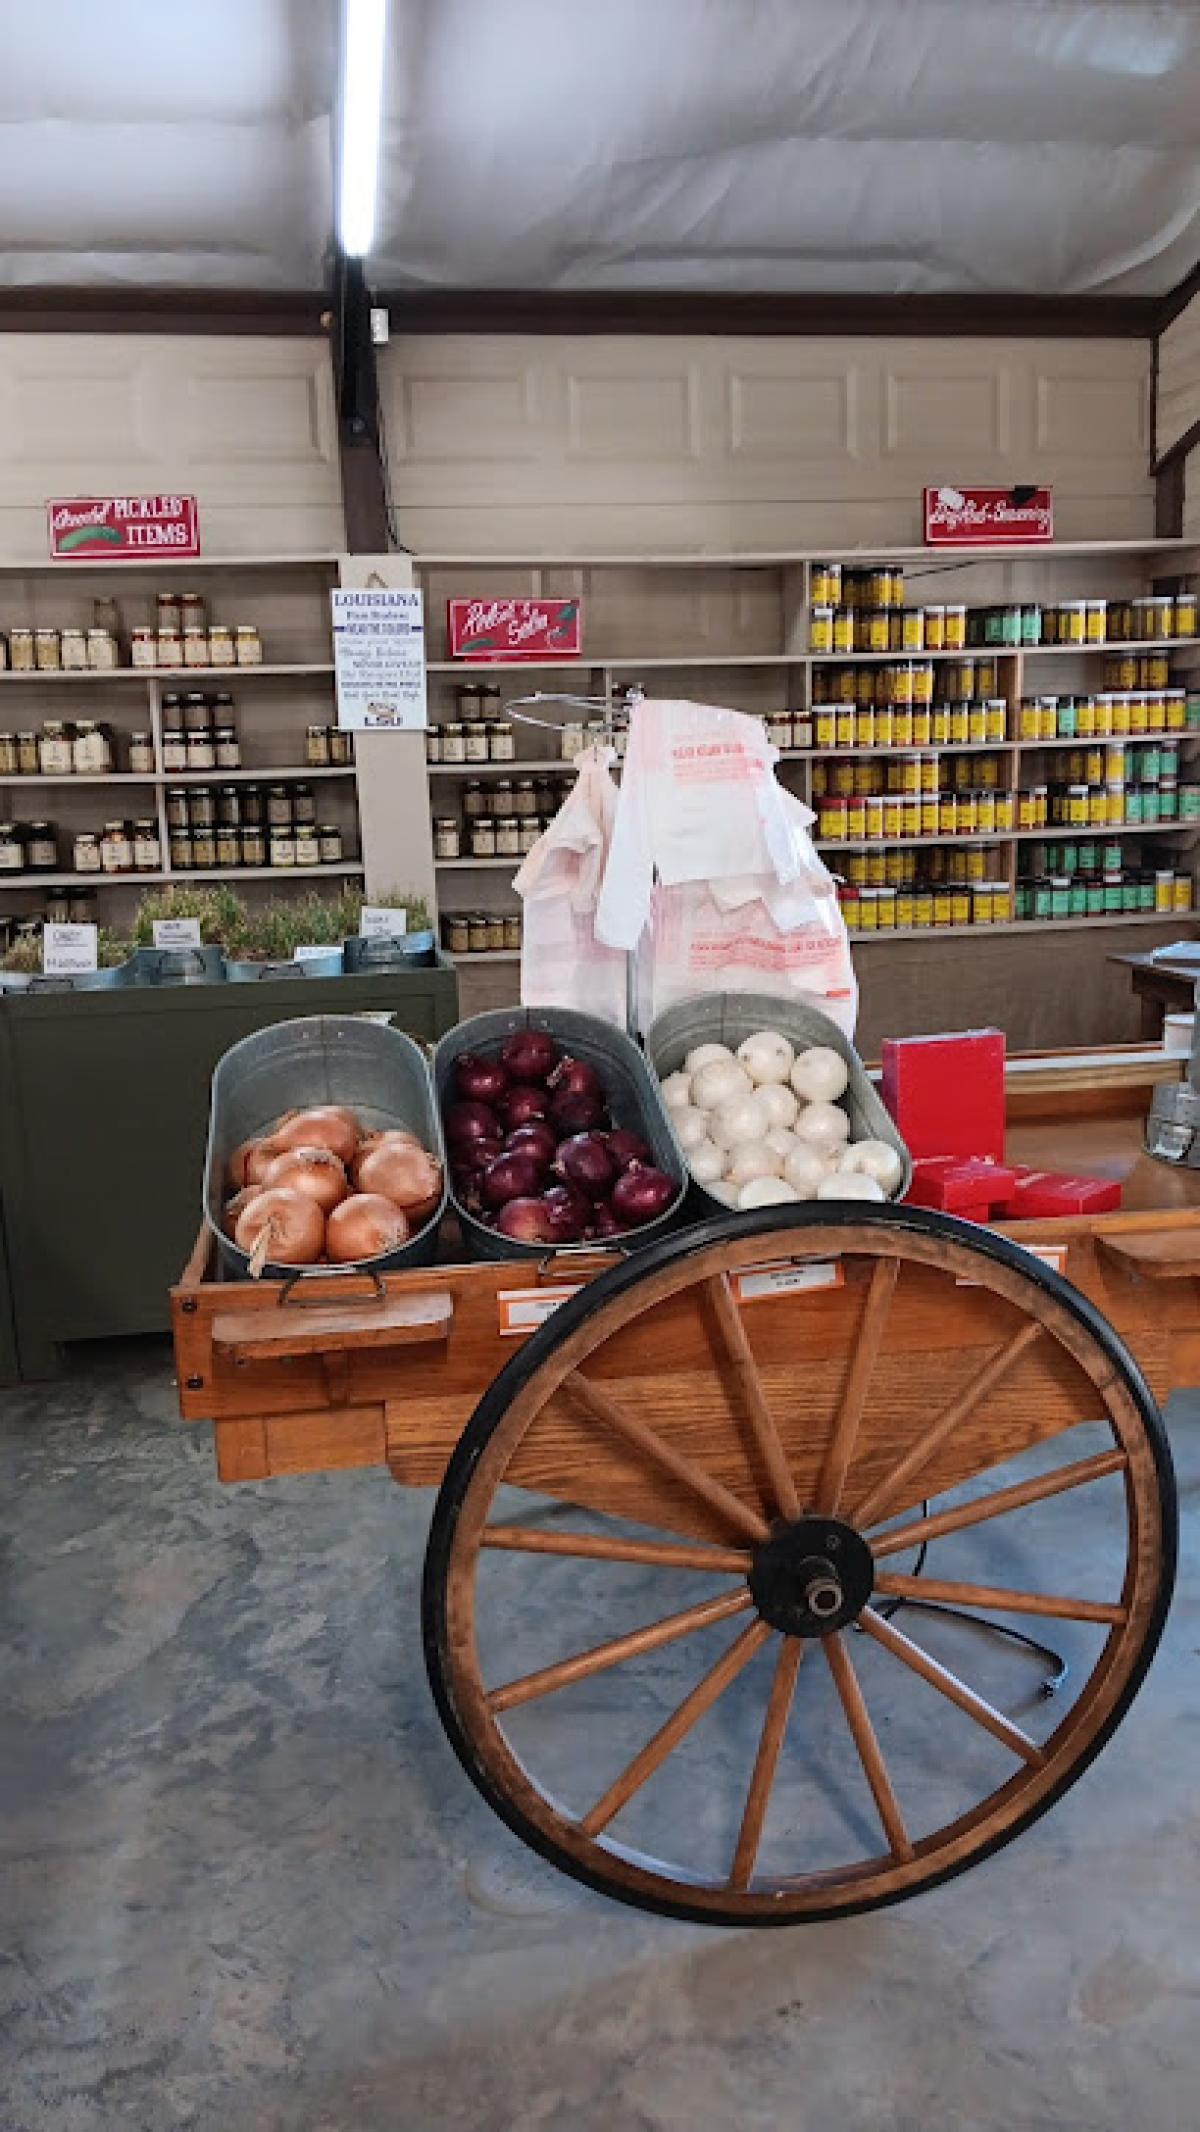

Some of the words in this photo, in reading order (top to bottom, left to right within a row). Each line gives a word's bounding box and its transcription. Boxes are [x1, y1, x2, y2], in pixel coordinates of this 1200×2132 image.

[114, 497, 183, 519] PICKLED
[127, 524, 188, 545] ITEMS
[335, 594, 418, 606] LOUISIANA
[364, 717, 403, 727] LSU
